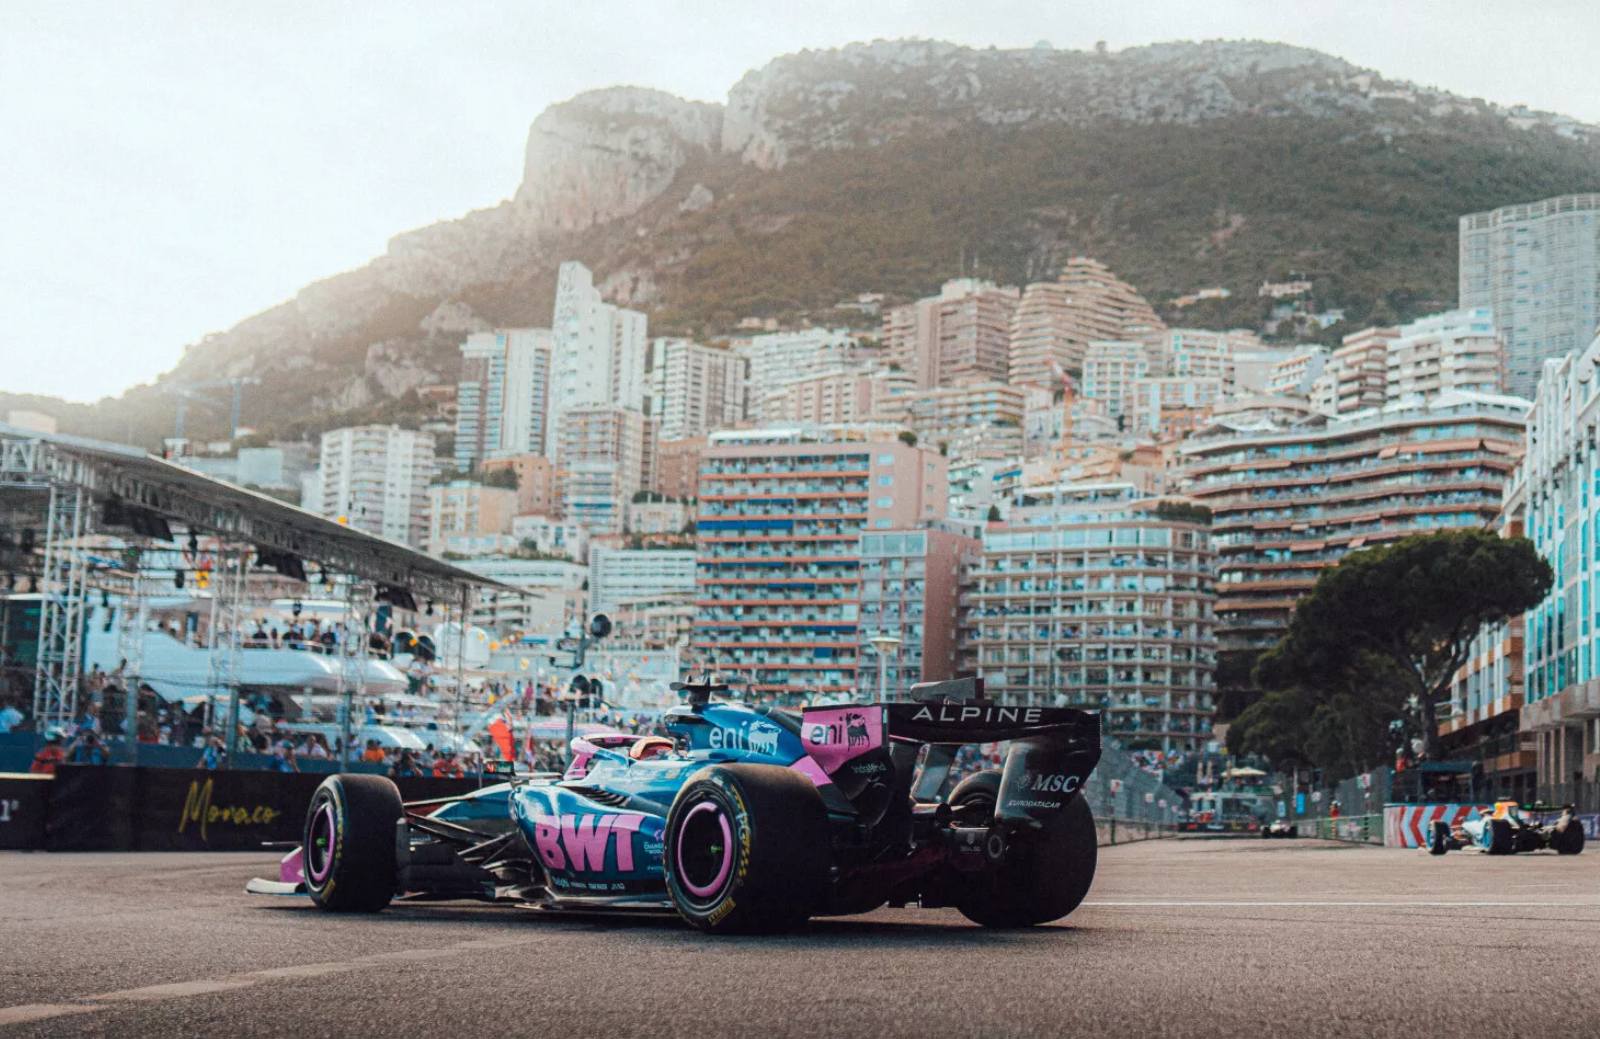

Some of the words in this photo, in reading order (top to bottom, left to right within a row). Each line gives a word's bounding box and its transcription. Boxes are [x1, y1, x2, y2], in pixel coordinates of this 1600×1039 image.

[911, 705, 1043, 724] ALPINE
[709, 720, 748, 750] eni
[810, 716, 844, 746] eni
[1030, 773, 1080, 794] MSC
[178, 777, 280, 843] Monaco
[1007, 800, 1062, 810] EURODATACAR
[535, 813, 647, 873] BWT
